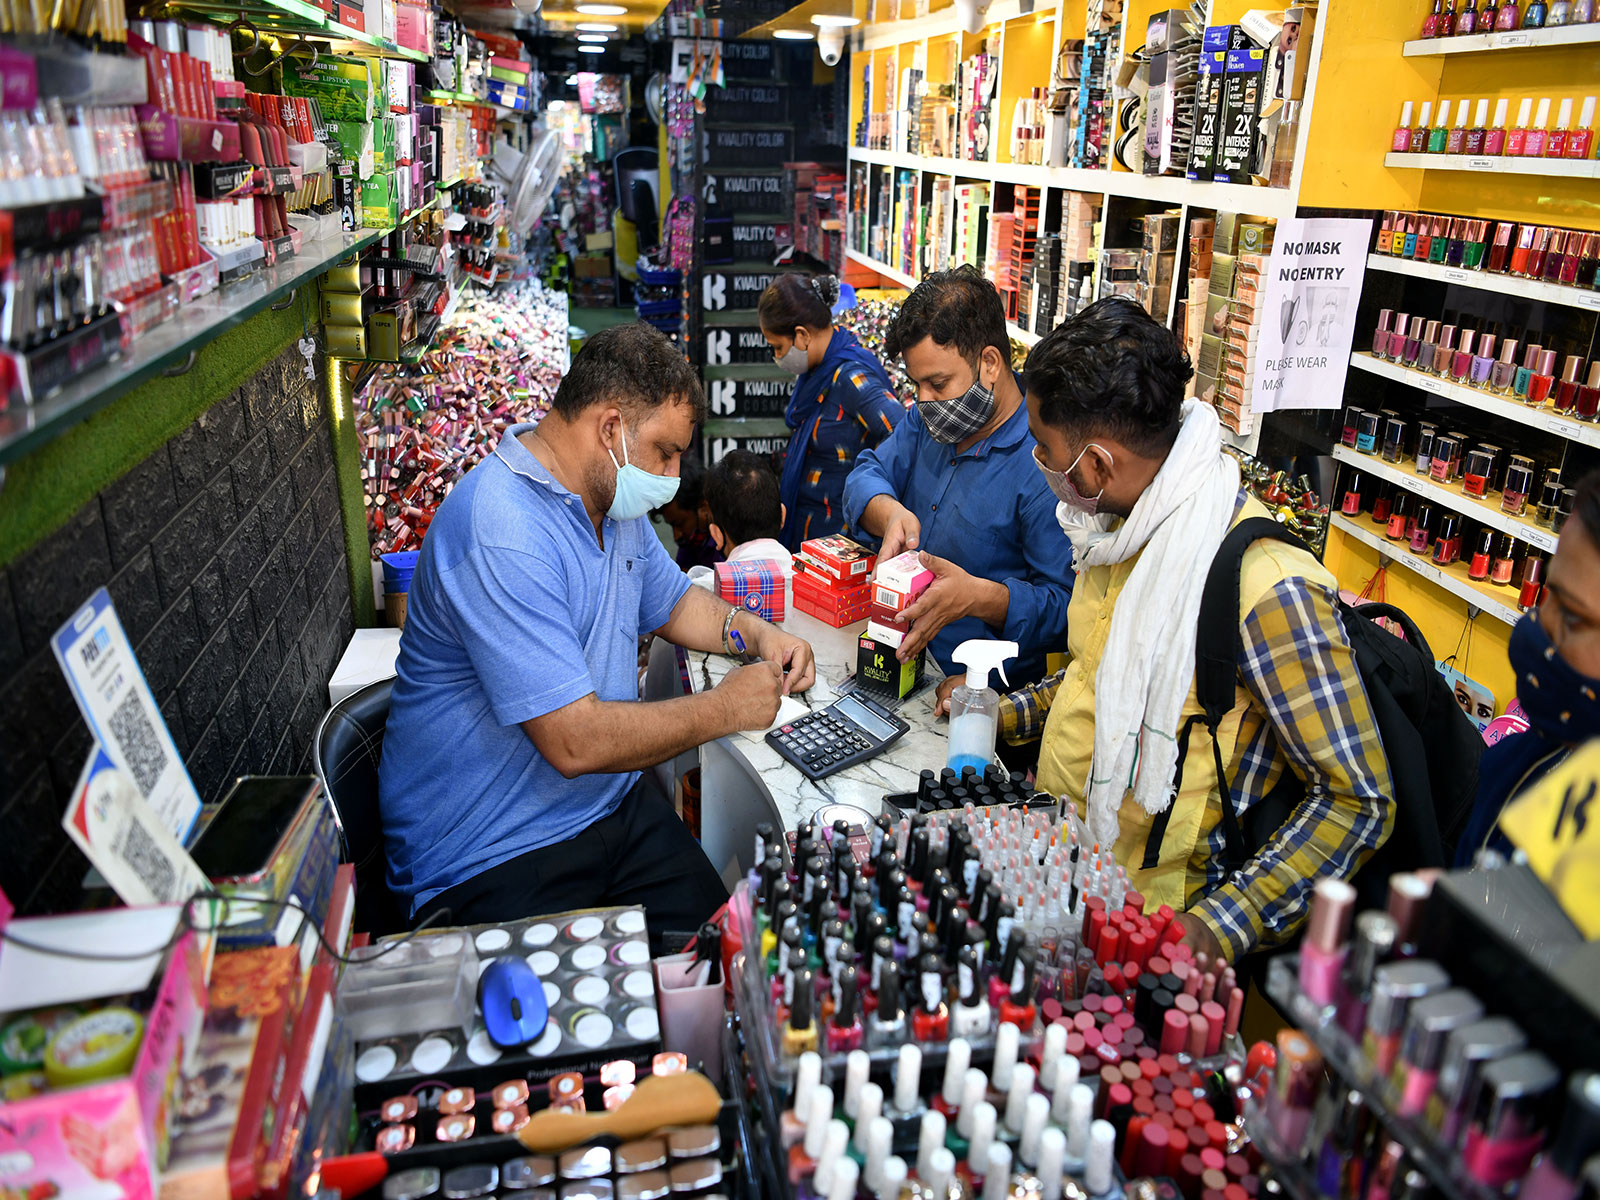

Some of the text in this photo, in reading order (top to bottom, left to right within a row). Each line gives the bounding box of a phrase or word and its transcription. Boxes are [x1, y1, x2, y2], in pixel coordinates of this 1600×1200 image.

[322, 76, 350, 84] LIPSTICK
[1201, 114, 1216, 134] 2X
[1234, 114, 1253, 135] 2X
[717, 133, 785, 147] KWALITY COLOR
[1225, 136, 1251, 147] INTENSE
[725, 178, 781, 193] KWALITY COL
[733, 226, 766, 241] WALITY
[1283, 241, 1342, 256] NO MASK
[1279, 267, 1345, 281] NO ENTRY
[734, 276, 774, 291] KWALITY
[1265, 356, 1328, 371] PLEASE WEAR
[745, 382, 786, 396] KWALITY
[1262, 377, 1285, 391] MASK
[712, 380, 736, 415] K
[747, 440, 788, 454] KWALITY
[874, 653, 884, 669] K
[864, 665, 890, 678] KWALITY
[527, 1062, 588, 1079] Professional
